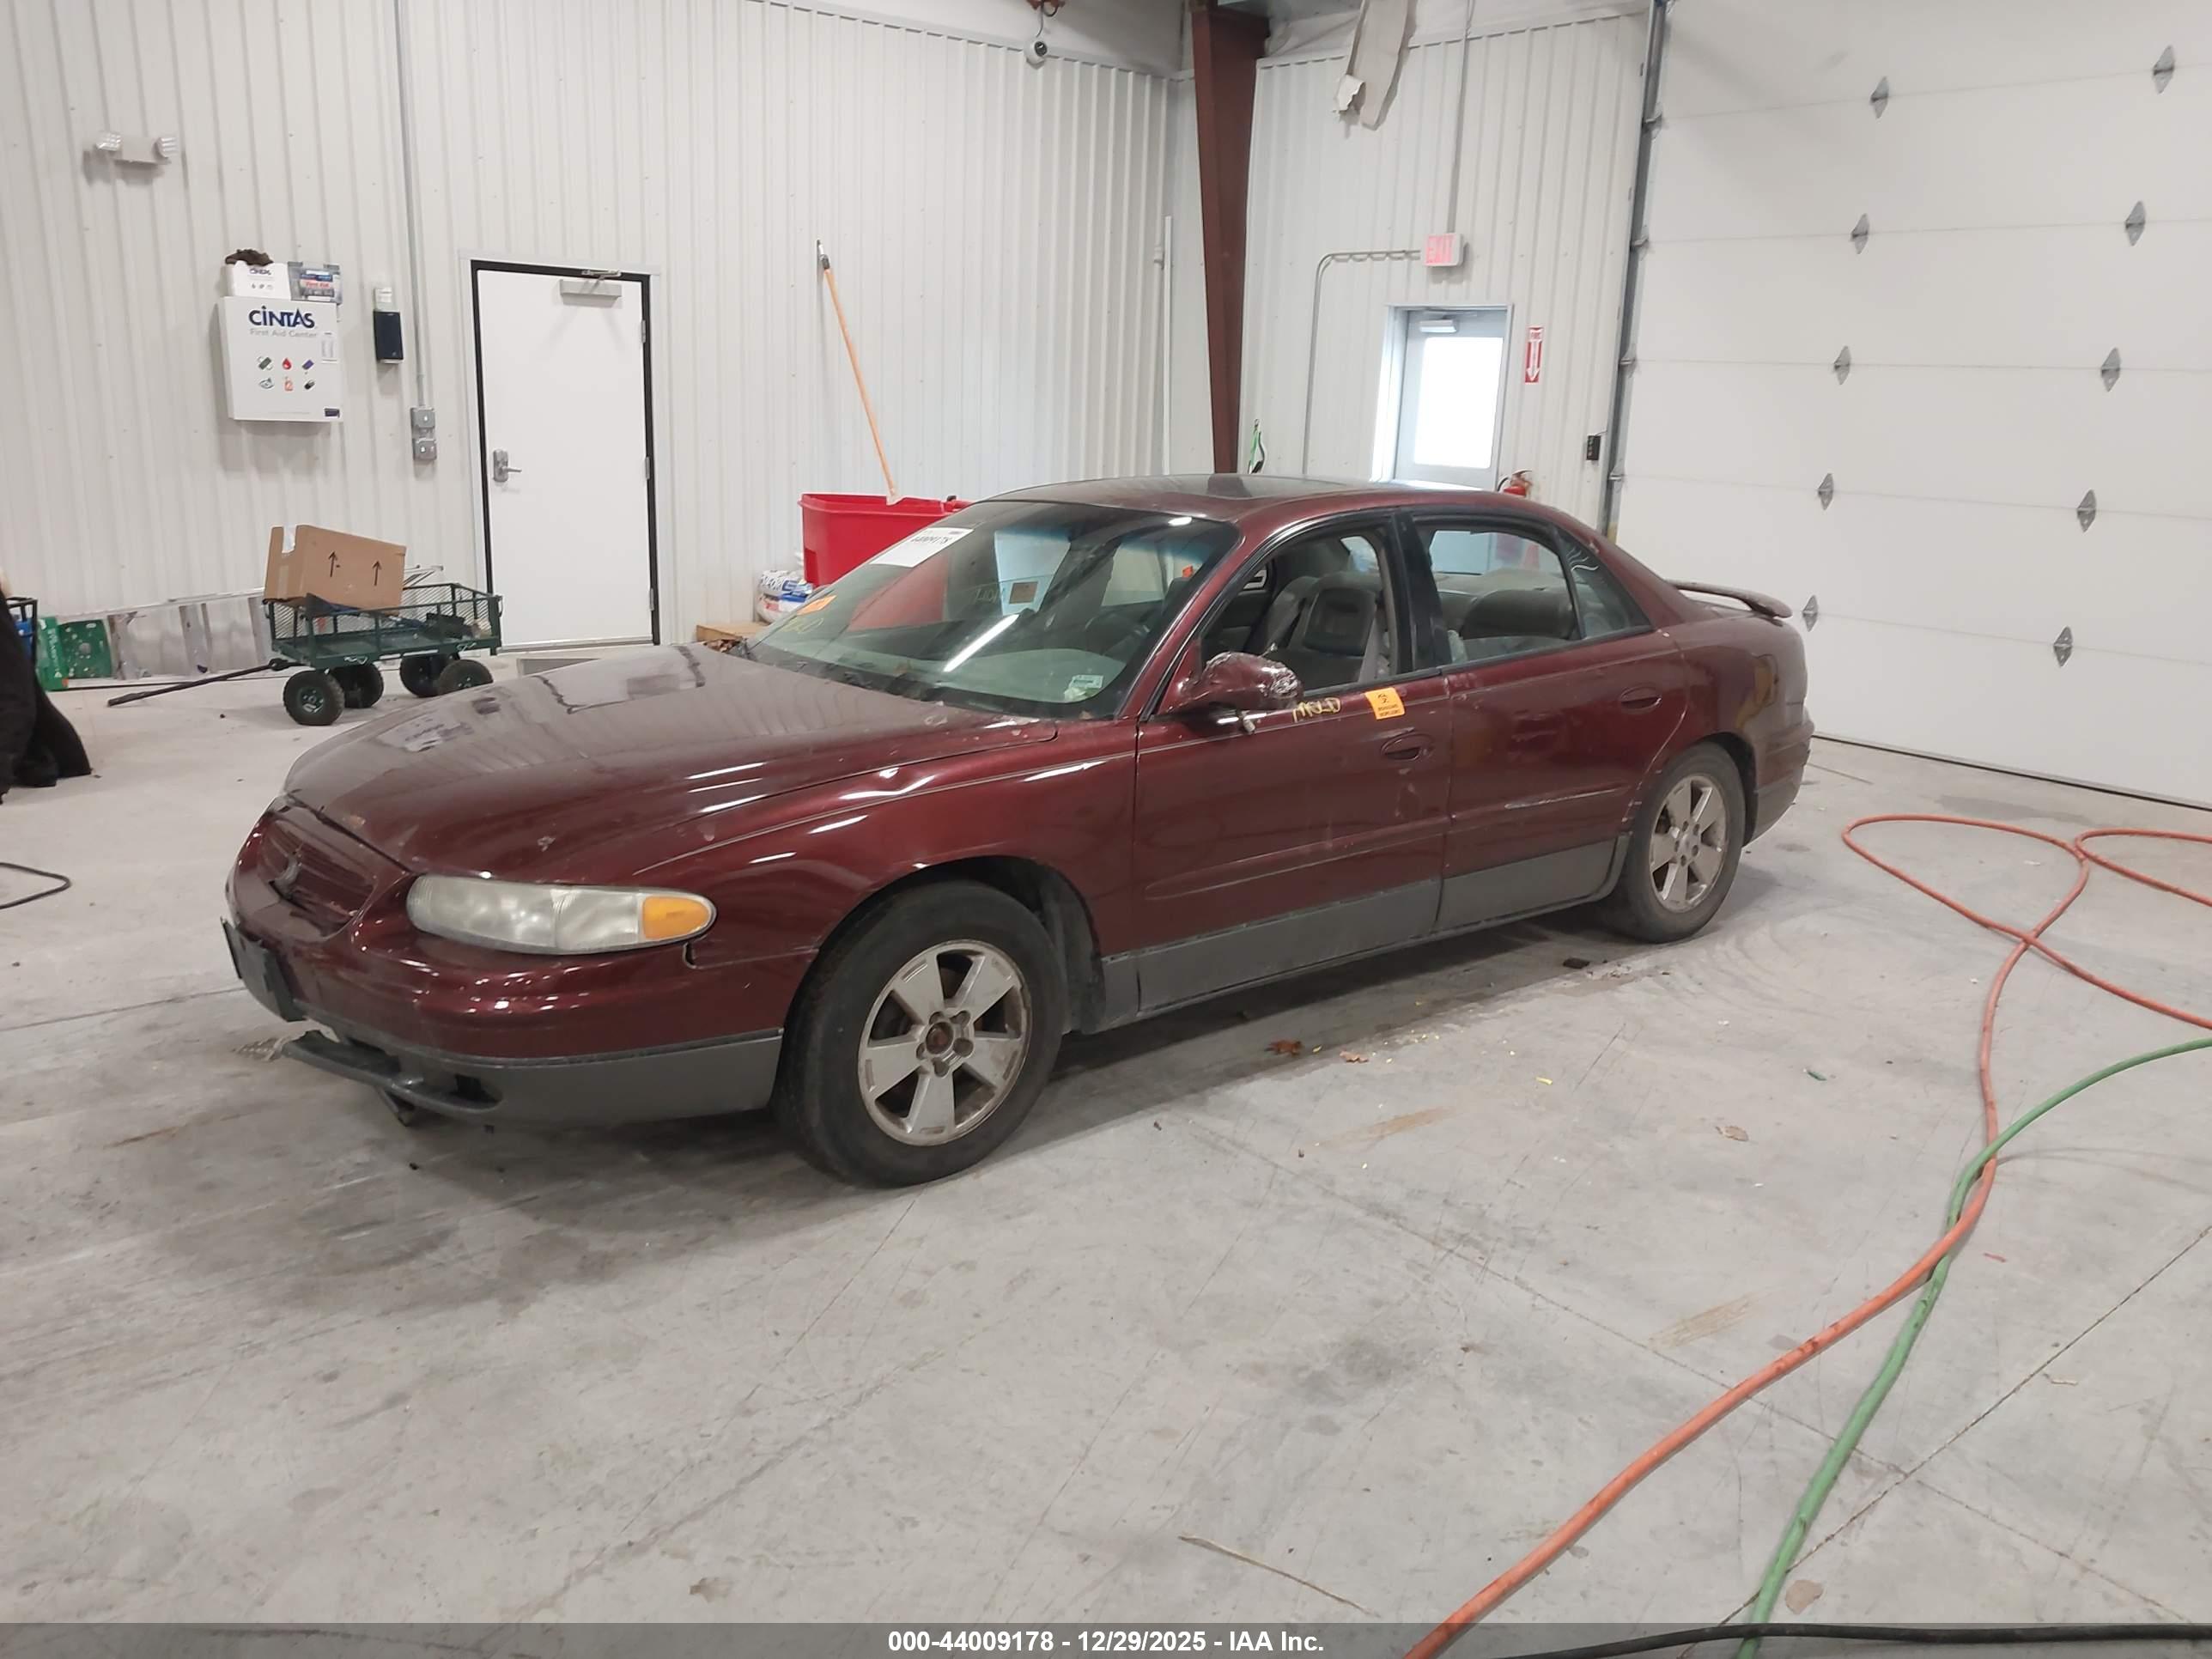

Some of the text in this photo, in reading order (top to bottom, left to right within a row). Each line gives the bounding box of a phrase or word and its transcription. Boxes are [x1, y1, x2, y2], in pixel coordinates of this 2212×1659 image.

[248, 305, 315, 329] CINTAS
[249, 328, 270, 337] First
[288, 330, 318, 338] Center
